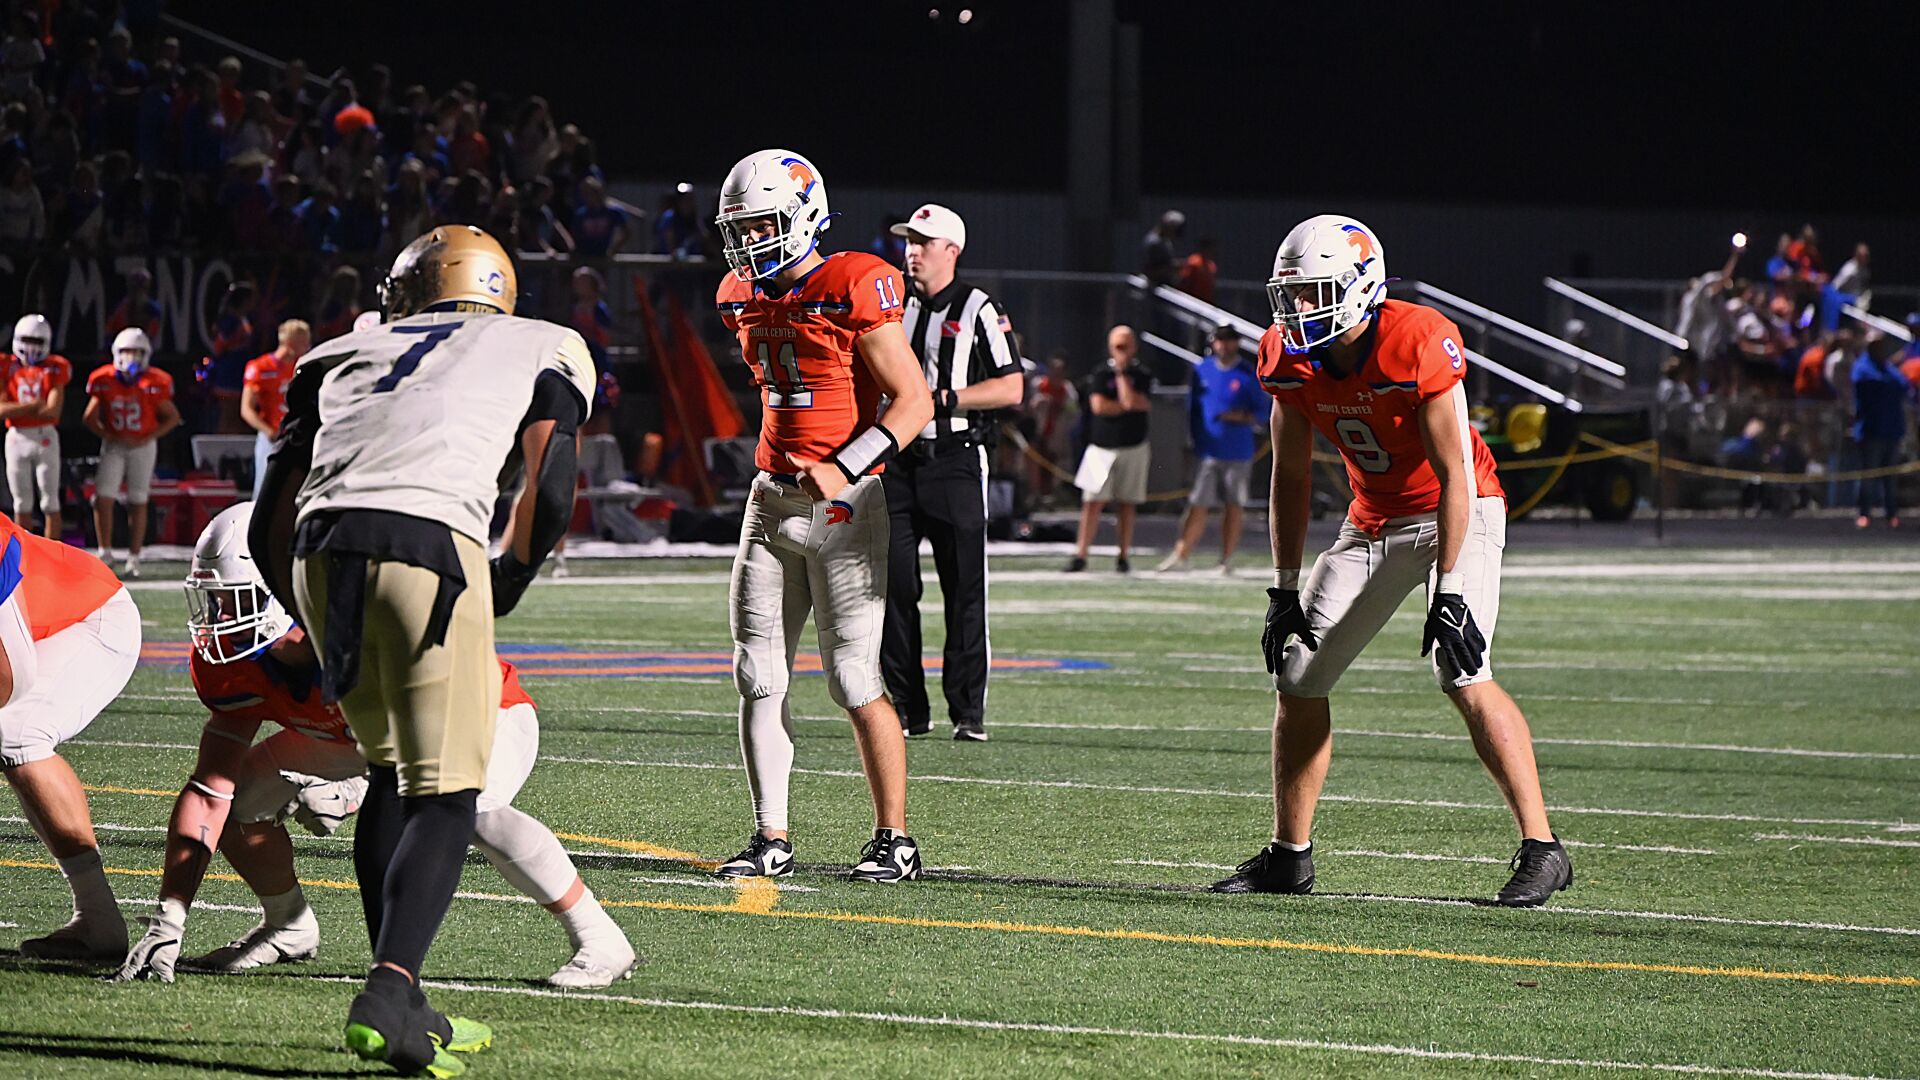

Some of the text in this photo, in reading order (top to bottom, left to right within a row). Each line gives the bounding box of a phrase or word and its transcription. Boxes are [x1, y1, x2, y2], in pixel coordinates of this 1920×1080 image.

[875, 275, 901, 311] 11
[750, 327, 797, 339] SIOUX CENTER
[371, 320, 465, 393] 7
[1441, 336, 1462, 370] 9
[757, 342, 814, 409] 11
[1341, 405, 1373, 415] CENTER
[1335, 417, 1392, 473] 9
